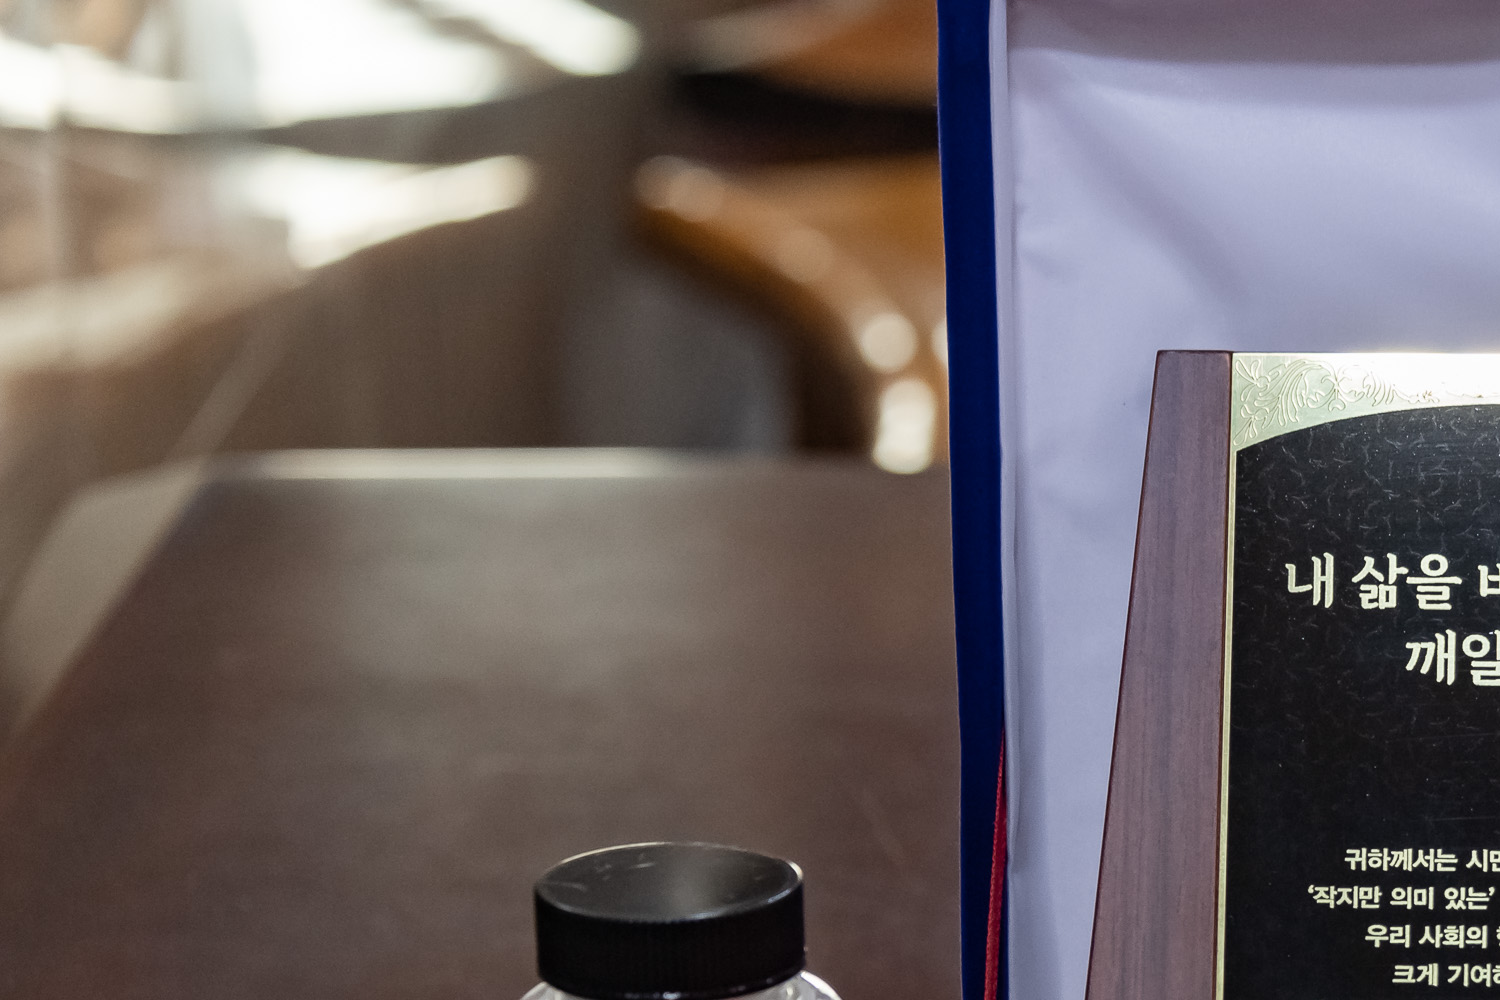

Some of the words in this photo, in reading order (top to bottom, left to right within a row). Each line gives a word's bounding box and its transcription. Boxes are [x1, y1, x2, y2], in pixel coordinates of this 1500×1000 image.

[1285, 552, 1334, 609] 내
[1352, 552, 1463, 611] 삶을
[1344, 848, 1458, 872] 귀하께서는
[1390, 886, 1434, 910] 의미
[1364, 924, 1411, 948] 우리
[1419, 925, 1488, 949] 사회의
[1392, 963, 1439, 987] 크게
